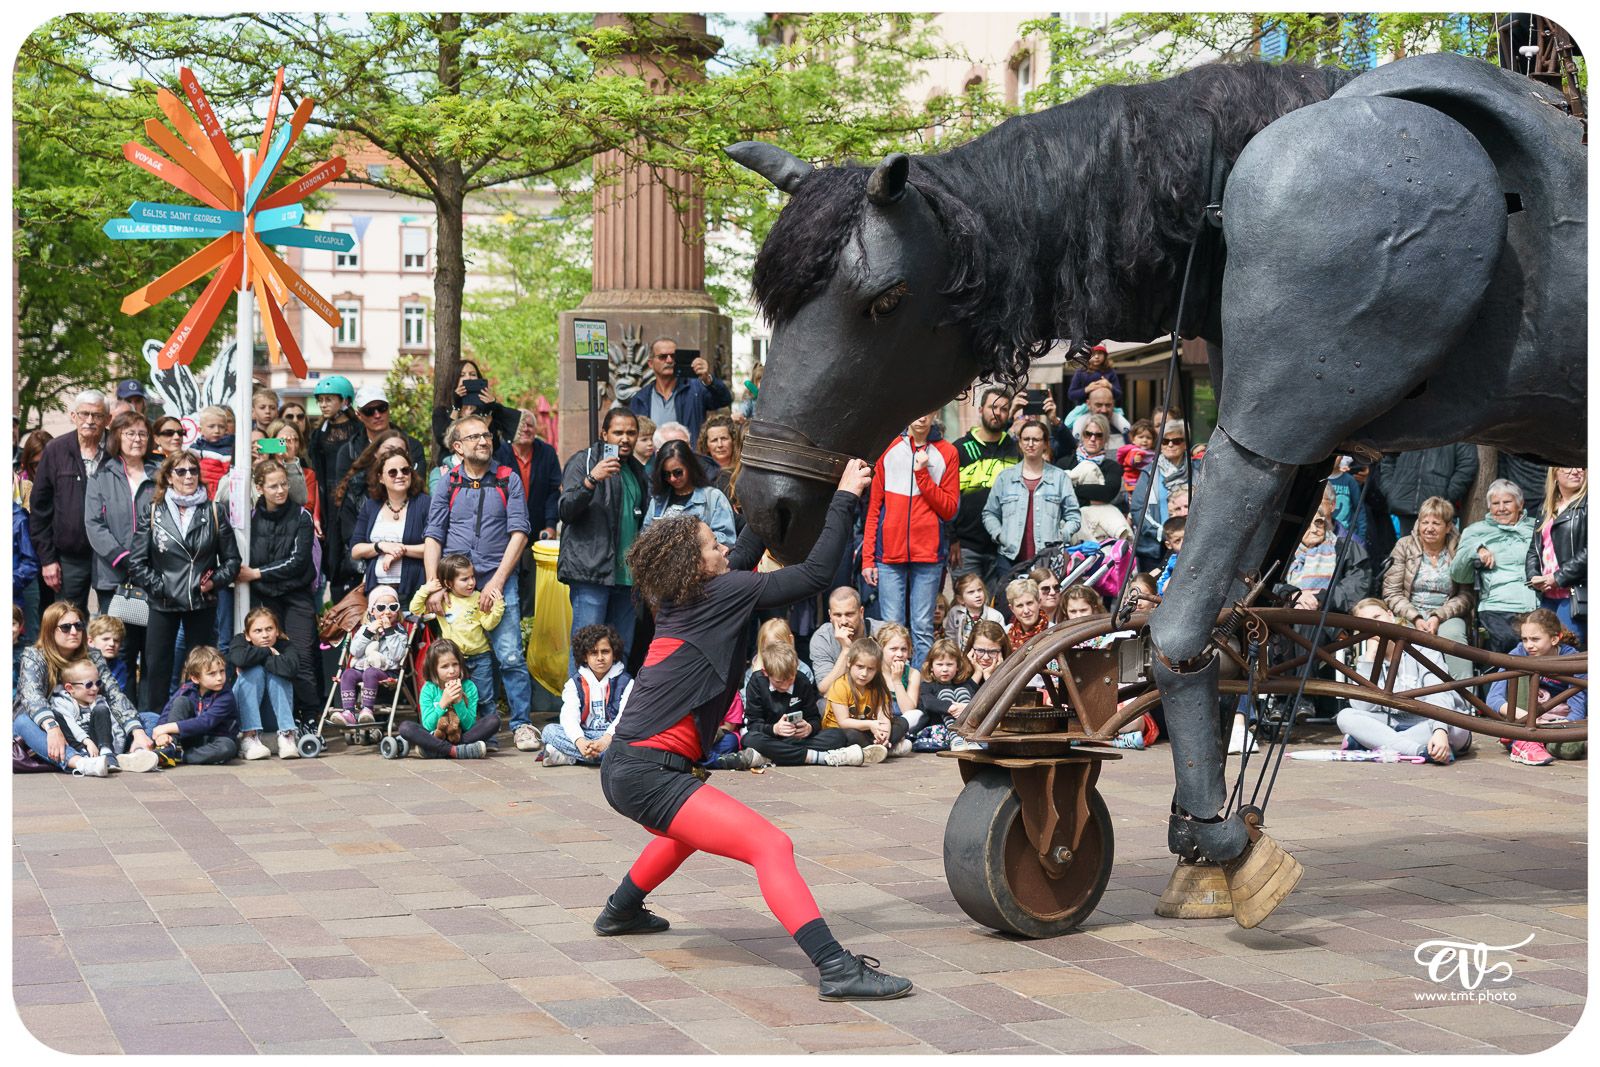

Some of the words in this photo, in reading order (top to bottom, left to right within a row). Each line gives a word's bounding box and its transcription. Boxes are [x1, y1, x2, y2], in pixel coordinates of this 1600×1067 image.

[188, 81, 198, 94] DO
[204, 113, 213, 126] MI
[134, 150, 164, 172] VOYAGE
[142, 206, 168, 219] ÉGLISE
[169, 211, 191, 221] SAINT
[193, 213, 222, 224] GEORGES
[116, 224, 151, 233] VILLAGE
[152, 224, 168, 233] DES
[314, 234, 345, 246] DÉCAPOLE
[294, 281, 334, 318] FESTIVALIER
[165, 342, 179, 360] DES
[177, 325, 192, 346] PAS
